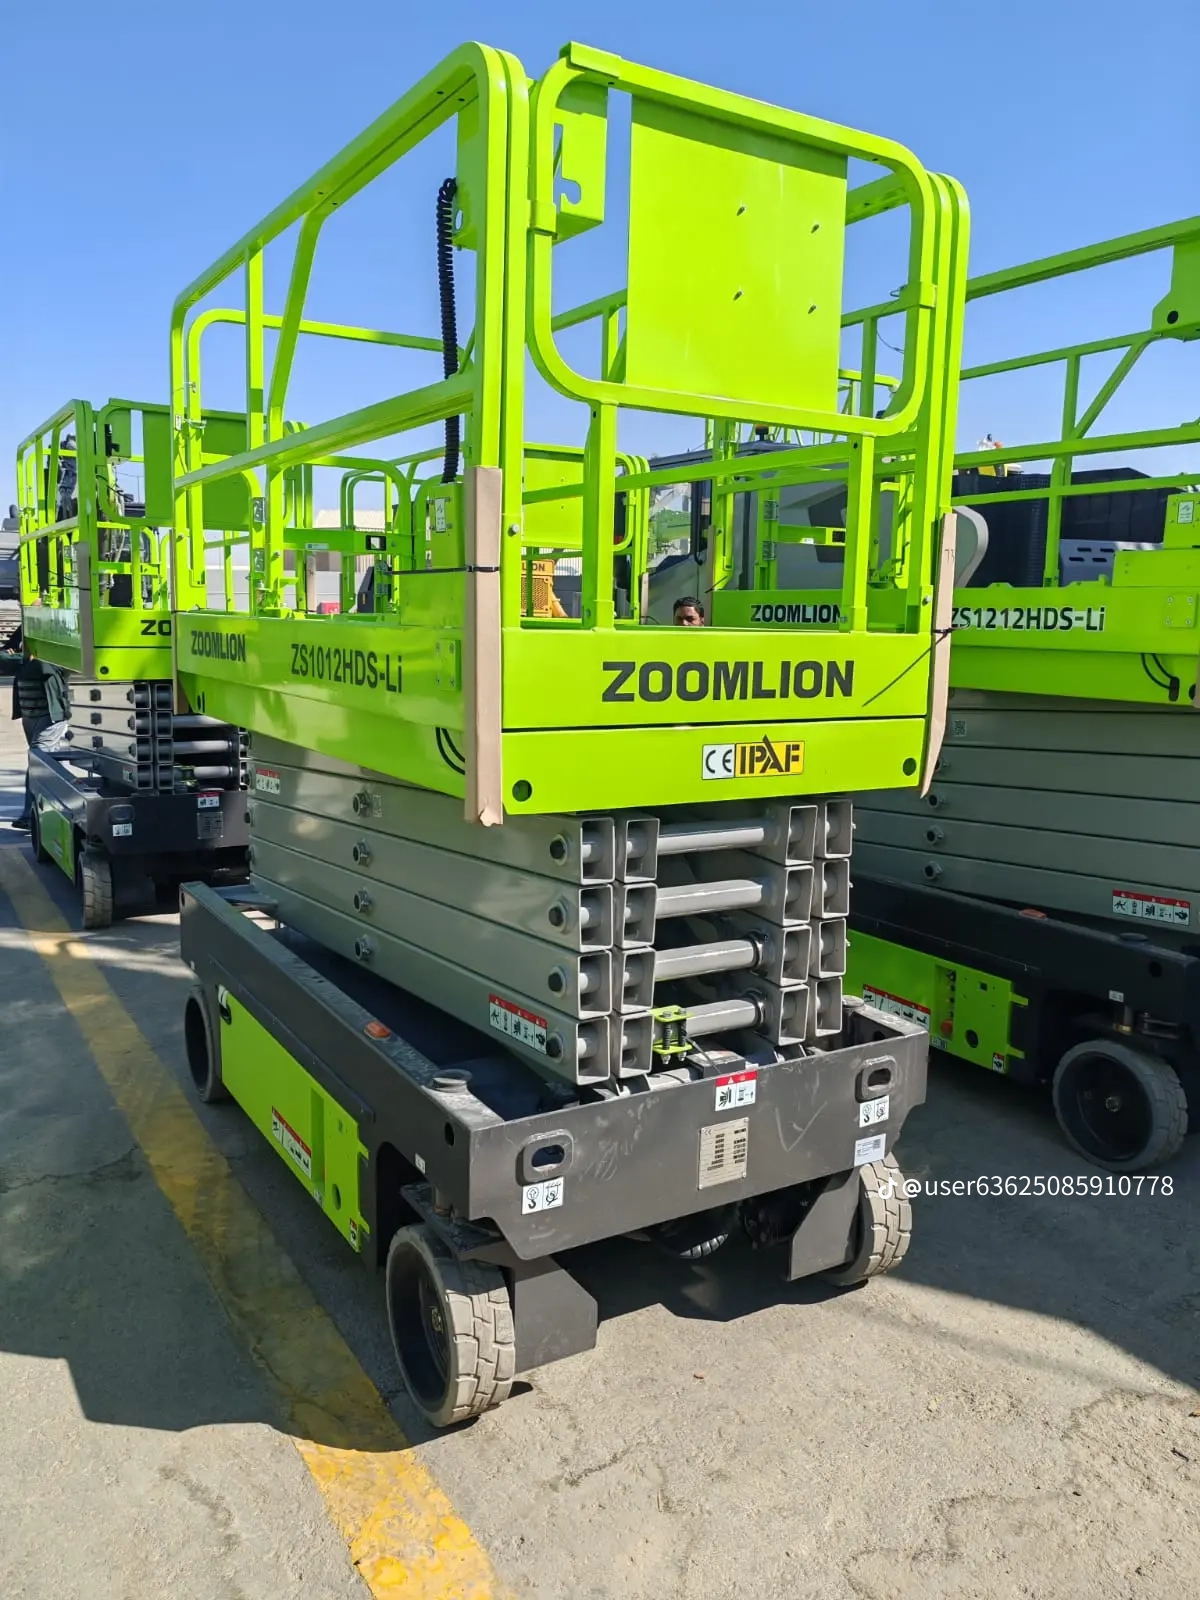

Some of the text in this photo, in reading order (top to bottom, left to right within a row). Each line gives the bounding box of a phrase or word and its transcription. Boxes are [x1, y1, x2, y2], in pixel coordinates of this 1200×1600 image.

[751, 604, 840, 623] ZOOMLION
[952, 607, 1105, 631] ZS1212HDS-Li
[191, 630, 246, 662] ZOOMLION
[291, 643, 402, 693] ZS1012HDS-Li
[602, 660, 854, 702] ZOOMLION
[705, 734, 800, 774] CE IPAF
